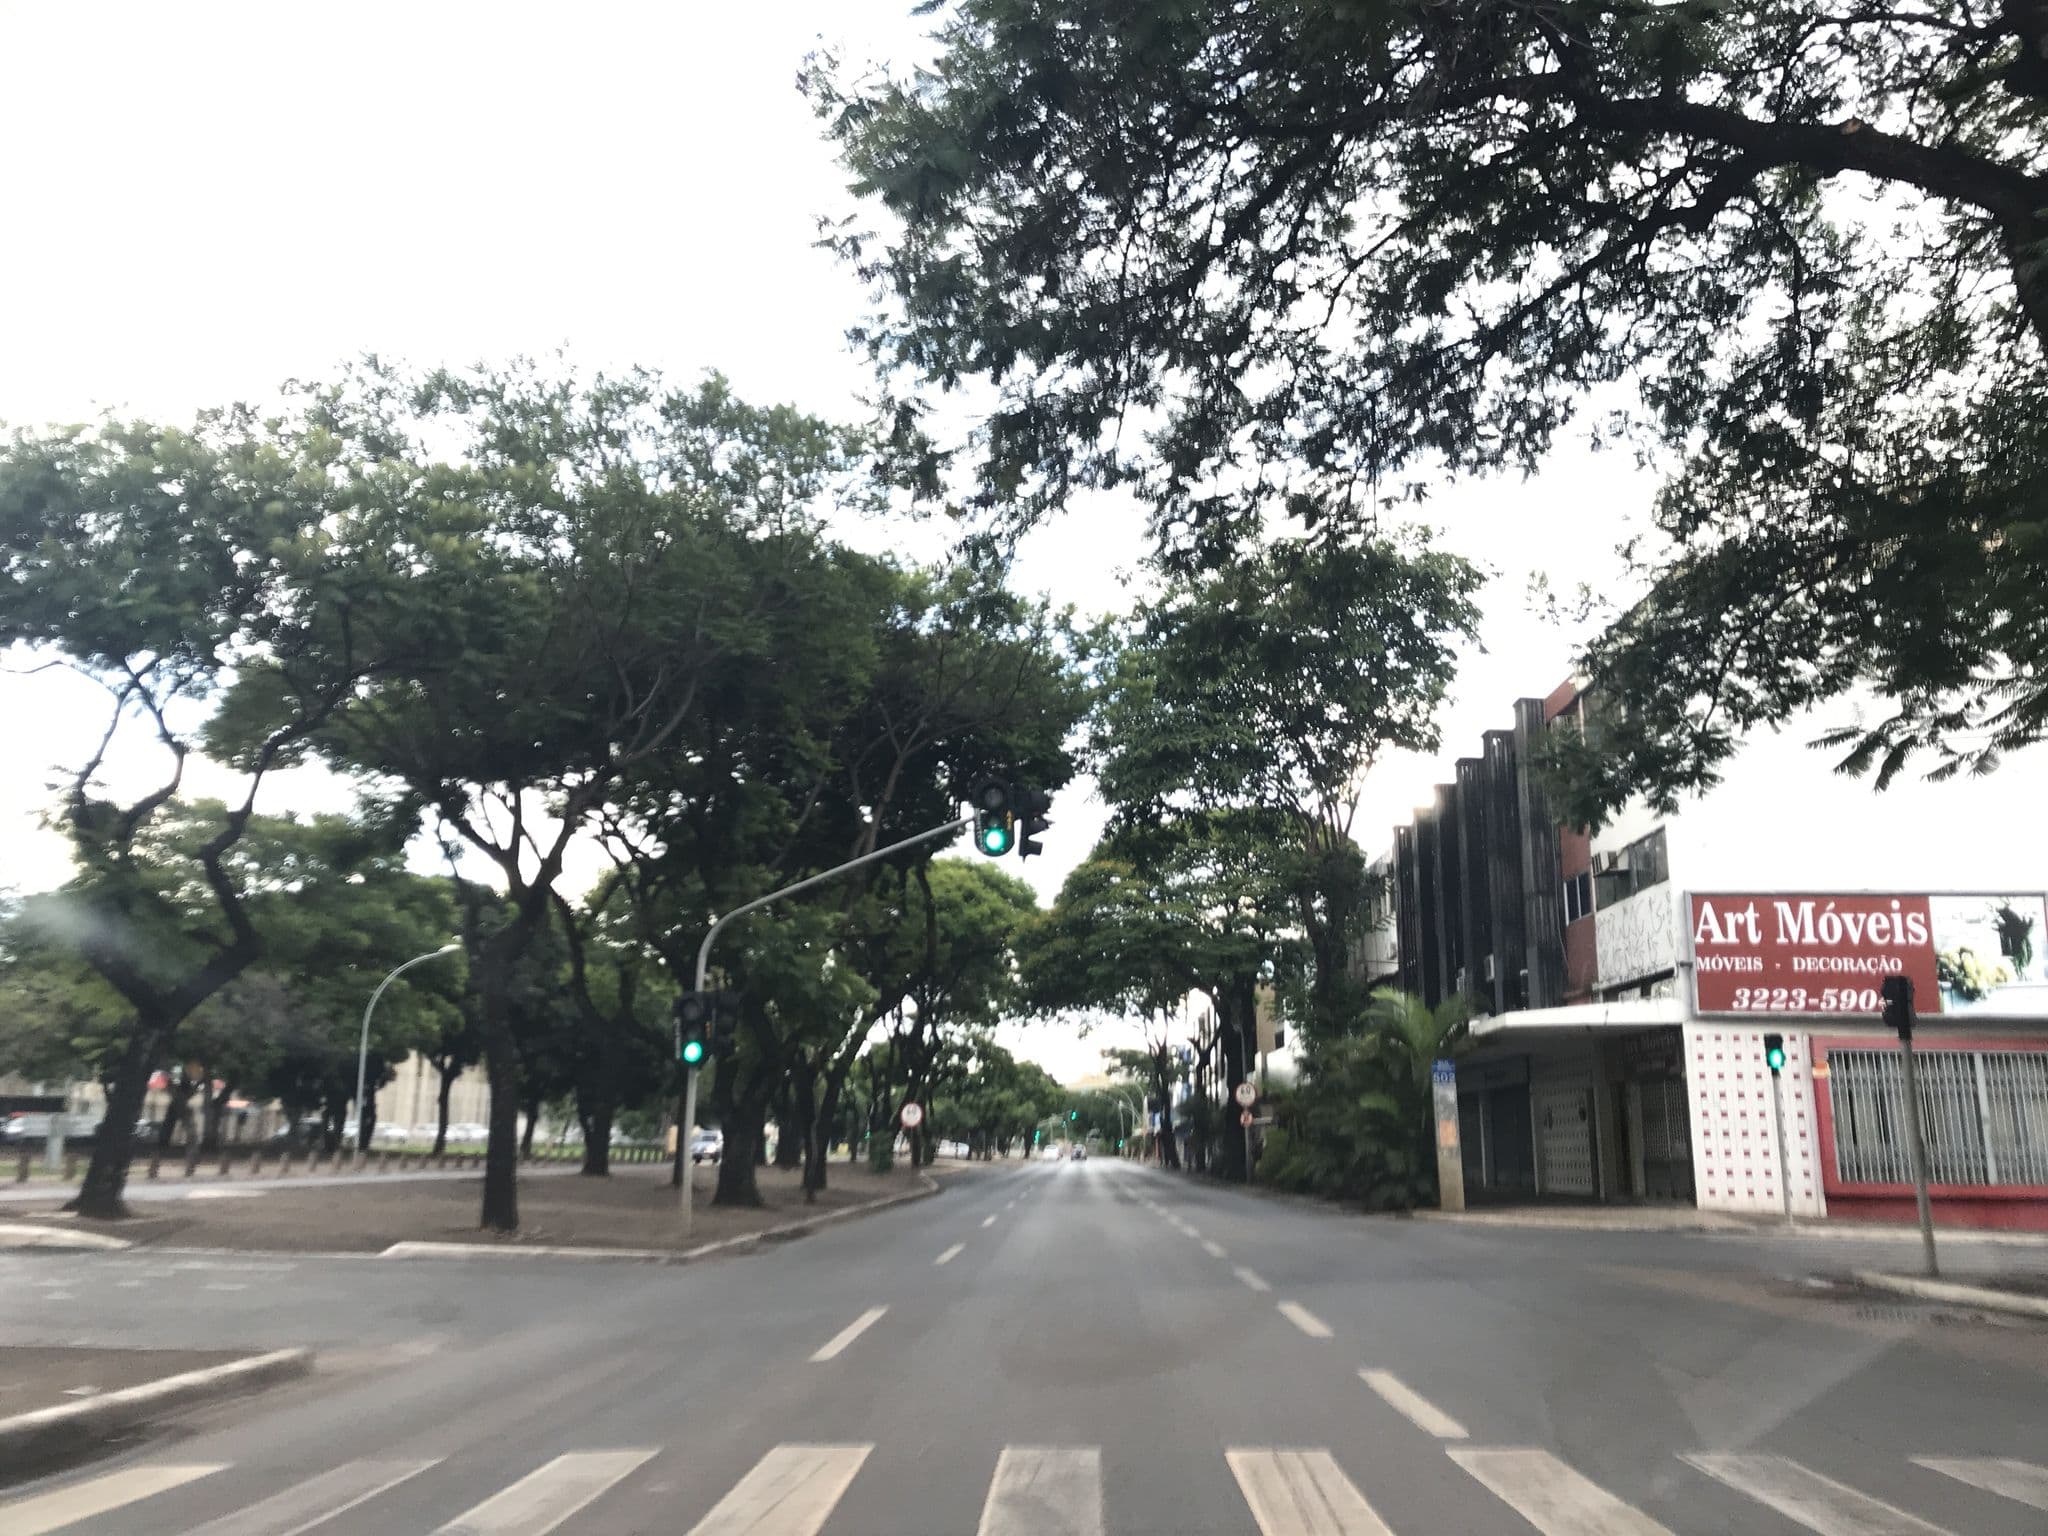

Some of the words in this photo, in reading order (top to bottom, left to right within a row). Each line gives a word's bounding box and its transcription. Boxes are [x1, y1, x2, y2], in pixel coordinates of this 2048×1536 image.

[1694, 900, 1762, 945] Art
[1774, 899, 1929, 946] Móveis
[1696, 954, 1764, 972] MÓVEIS
[1792, 955, 1903, 976] DECORAÇÃO
